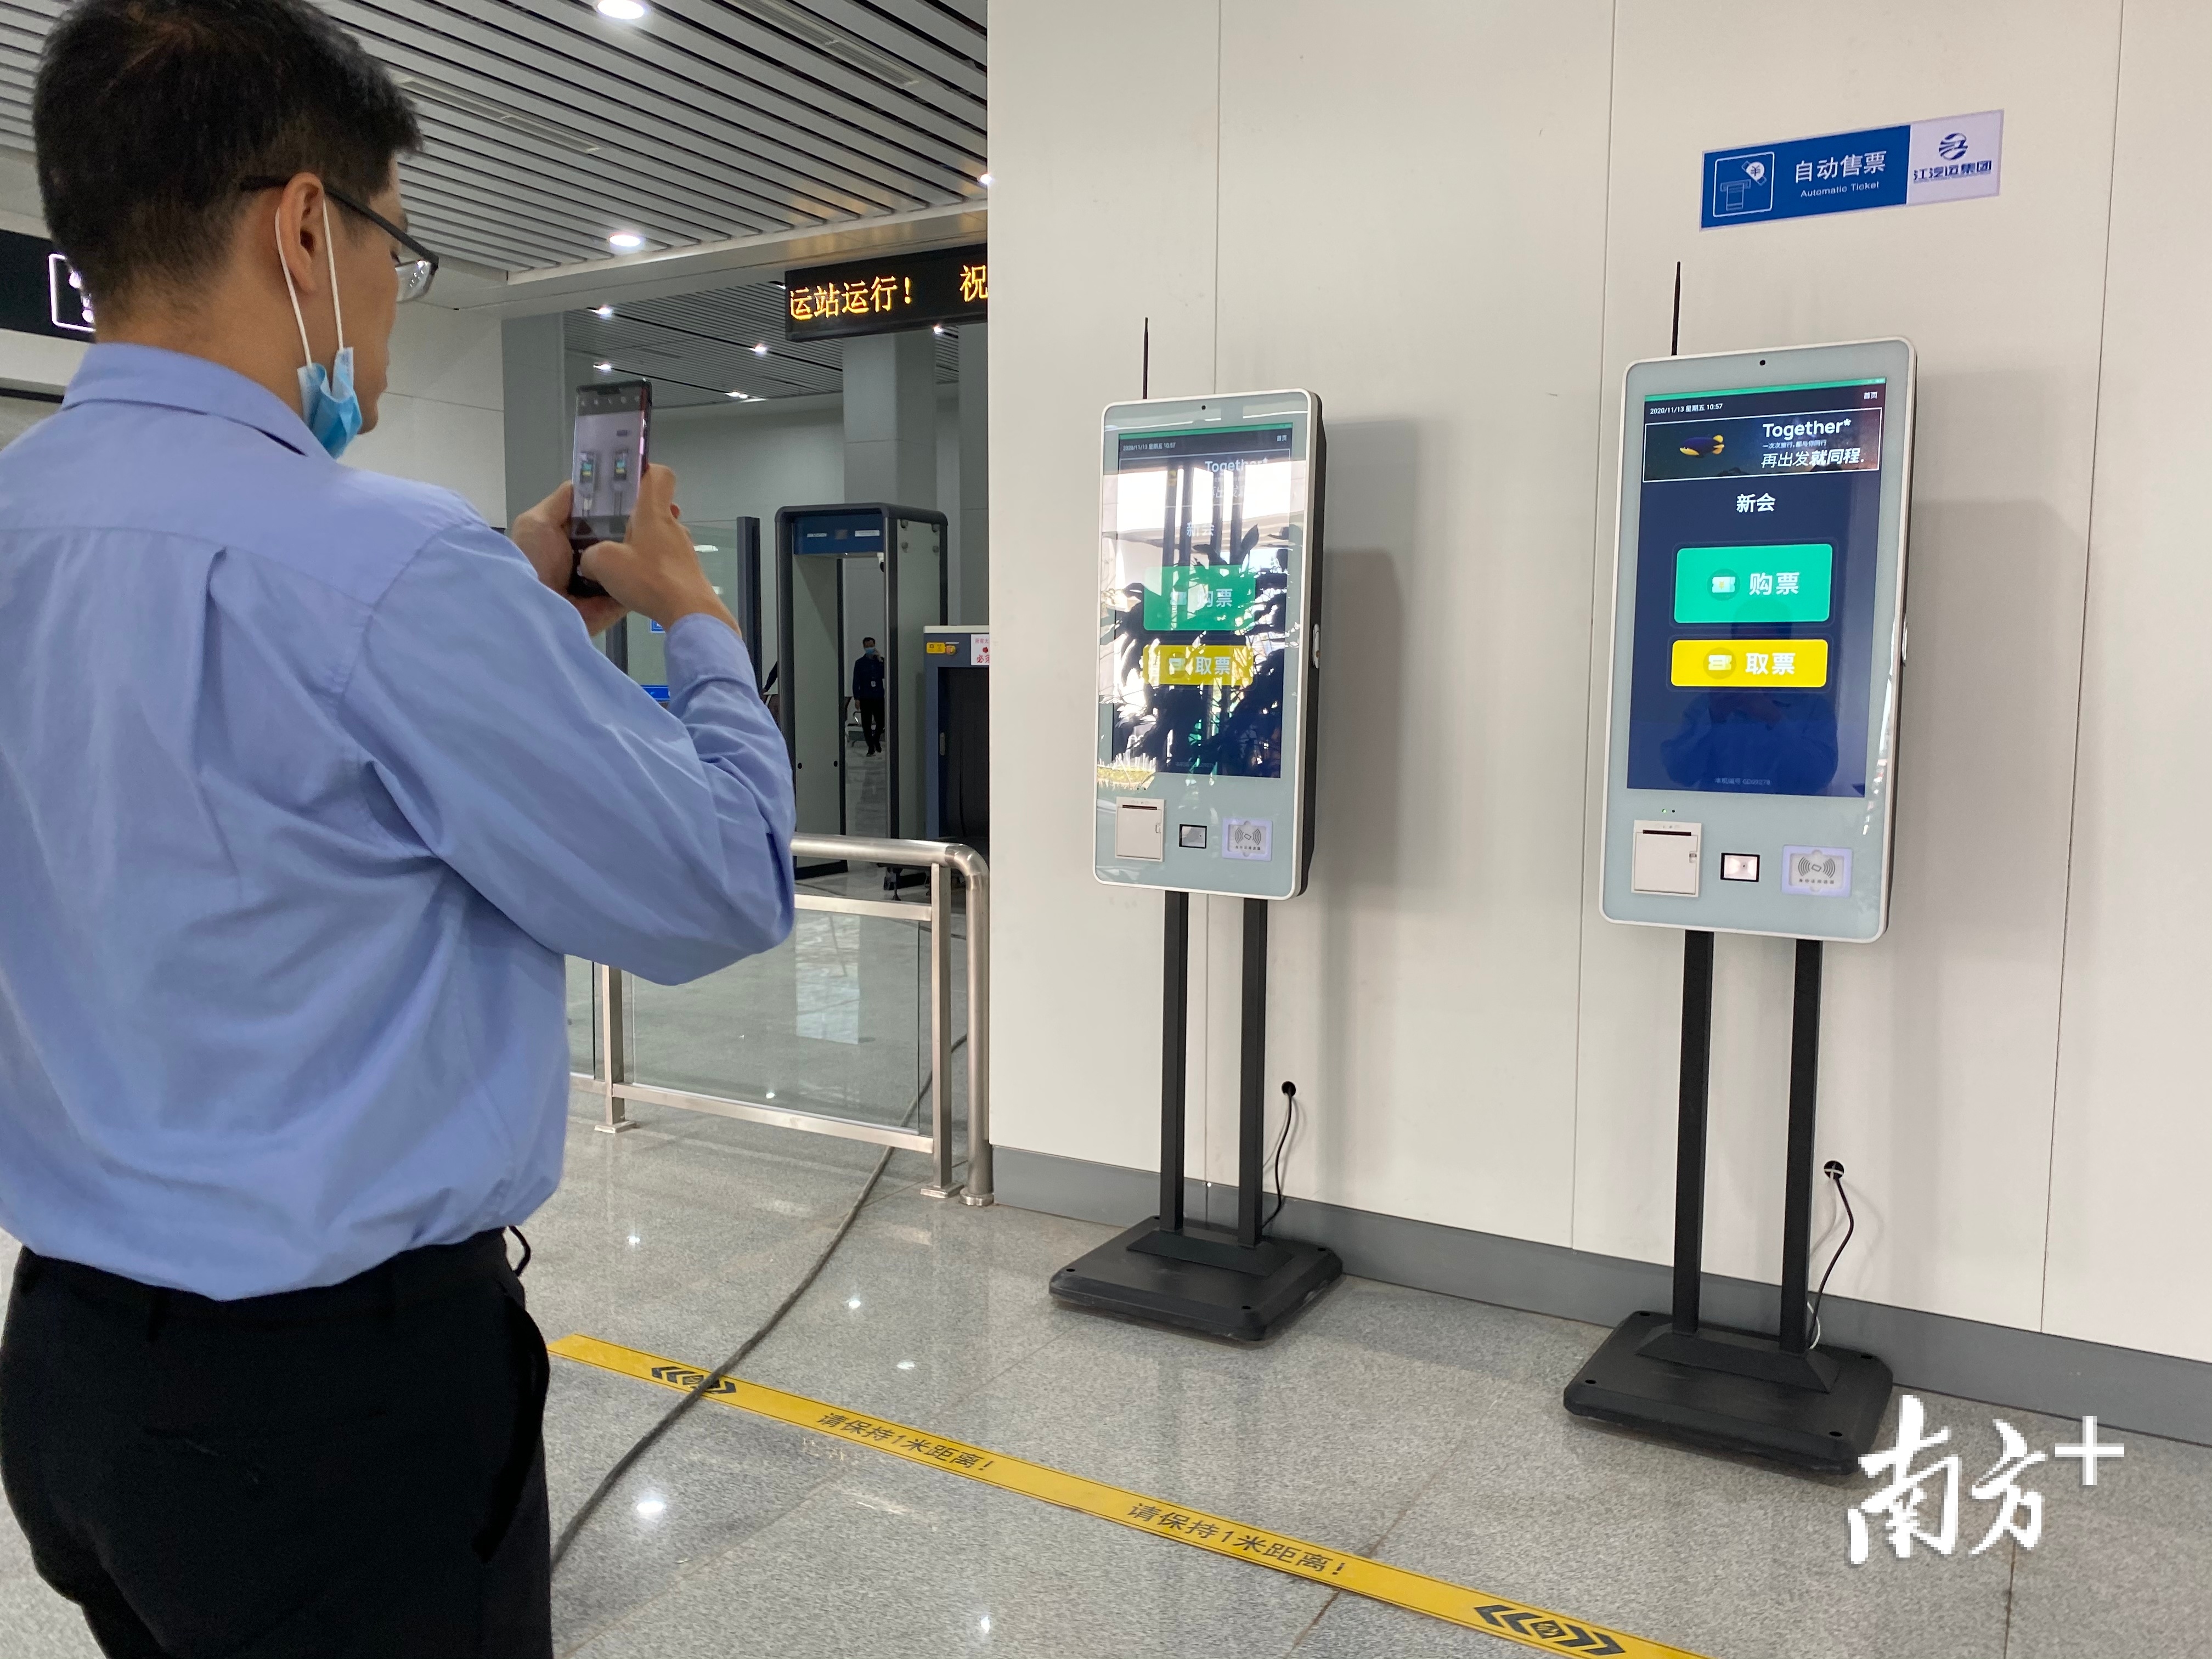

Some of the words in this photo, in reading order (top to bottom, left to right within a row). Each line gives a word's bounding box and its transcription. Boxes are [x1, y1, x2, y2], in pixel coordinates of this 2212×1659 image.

[1795, 150, 1887, 183] 自动售票
[1801, 185, 1847, 198] Automatic
[1850, 180, 1880, 191] Ticket
[790, 275, 913, 320] 运站运行！
[960, 264, 988, 303] 祝
[1650, 406, 1684, 414] 2020/11/13
[1685, 404, 1705, 413] 星期五
[1736, 493, 1776, 513] 新会
[1749, 572, 1799, 596] 购票
[1195, 657, 1231, 675] 取票
[1745, 652, 1796, 675] 取票
[816, 1413, 995, 1471] 请保持1米距离！
[1127, 1503, 1345, 1576] 请保持1米距离！
